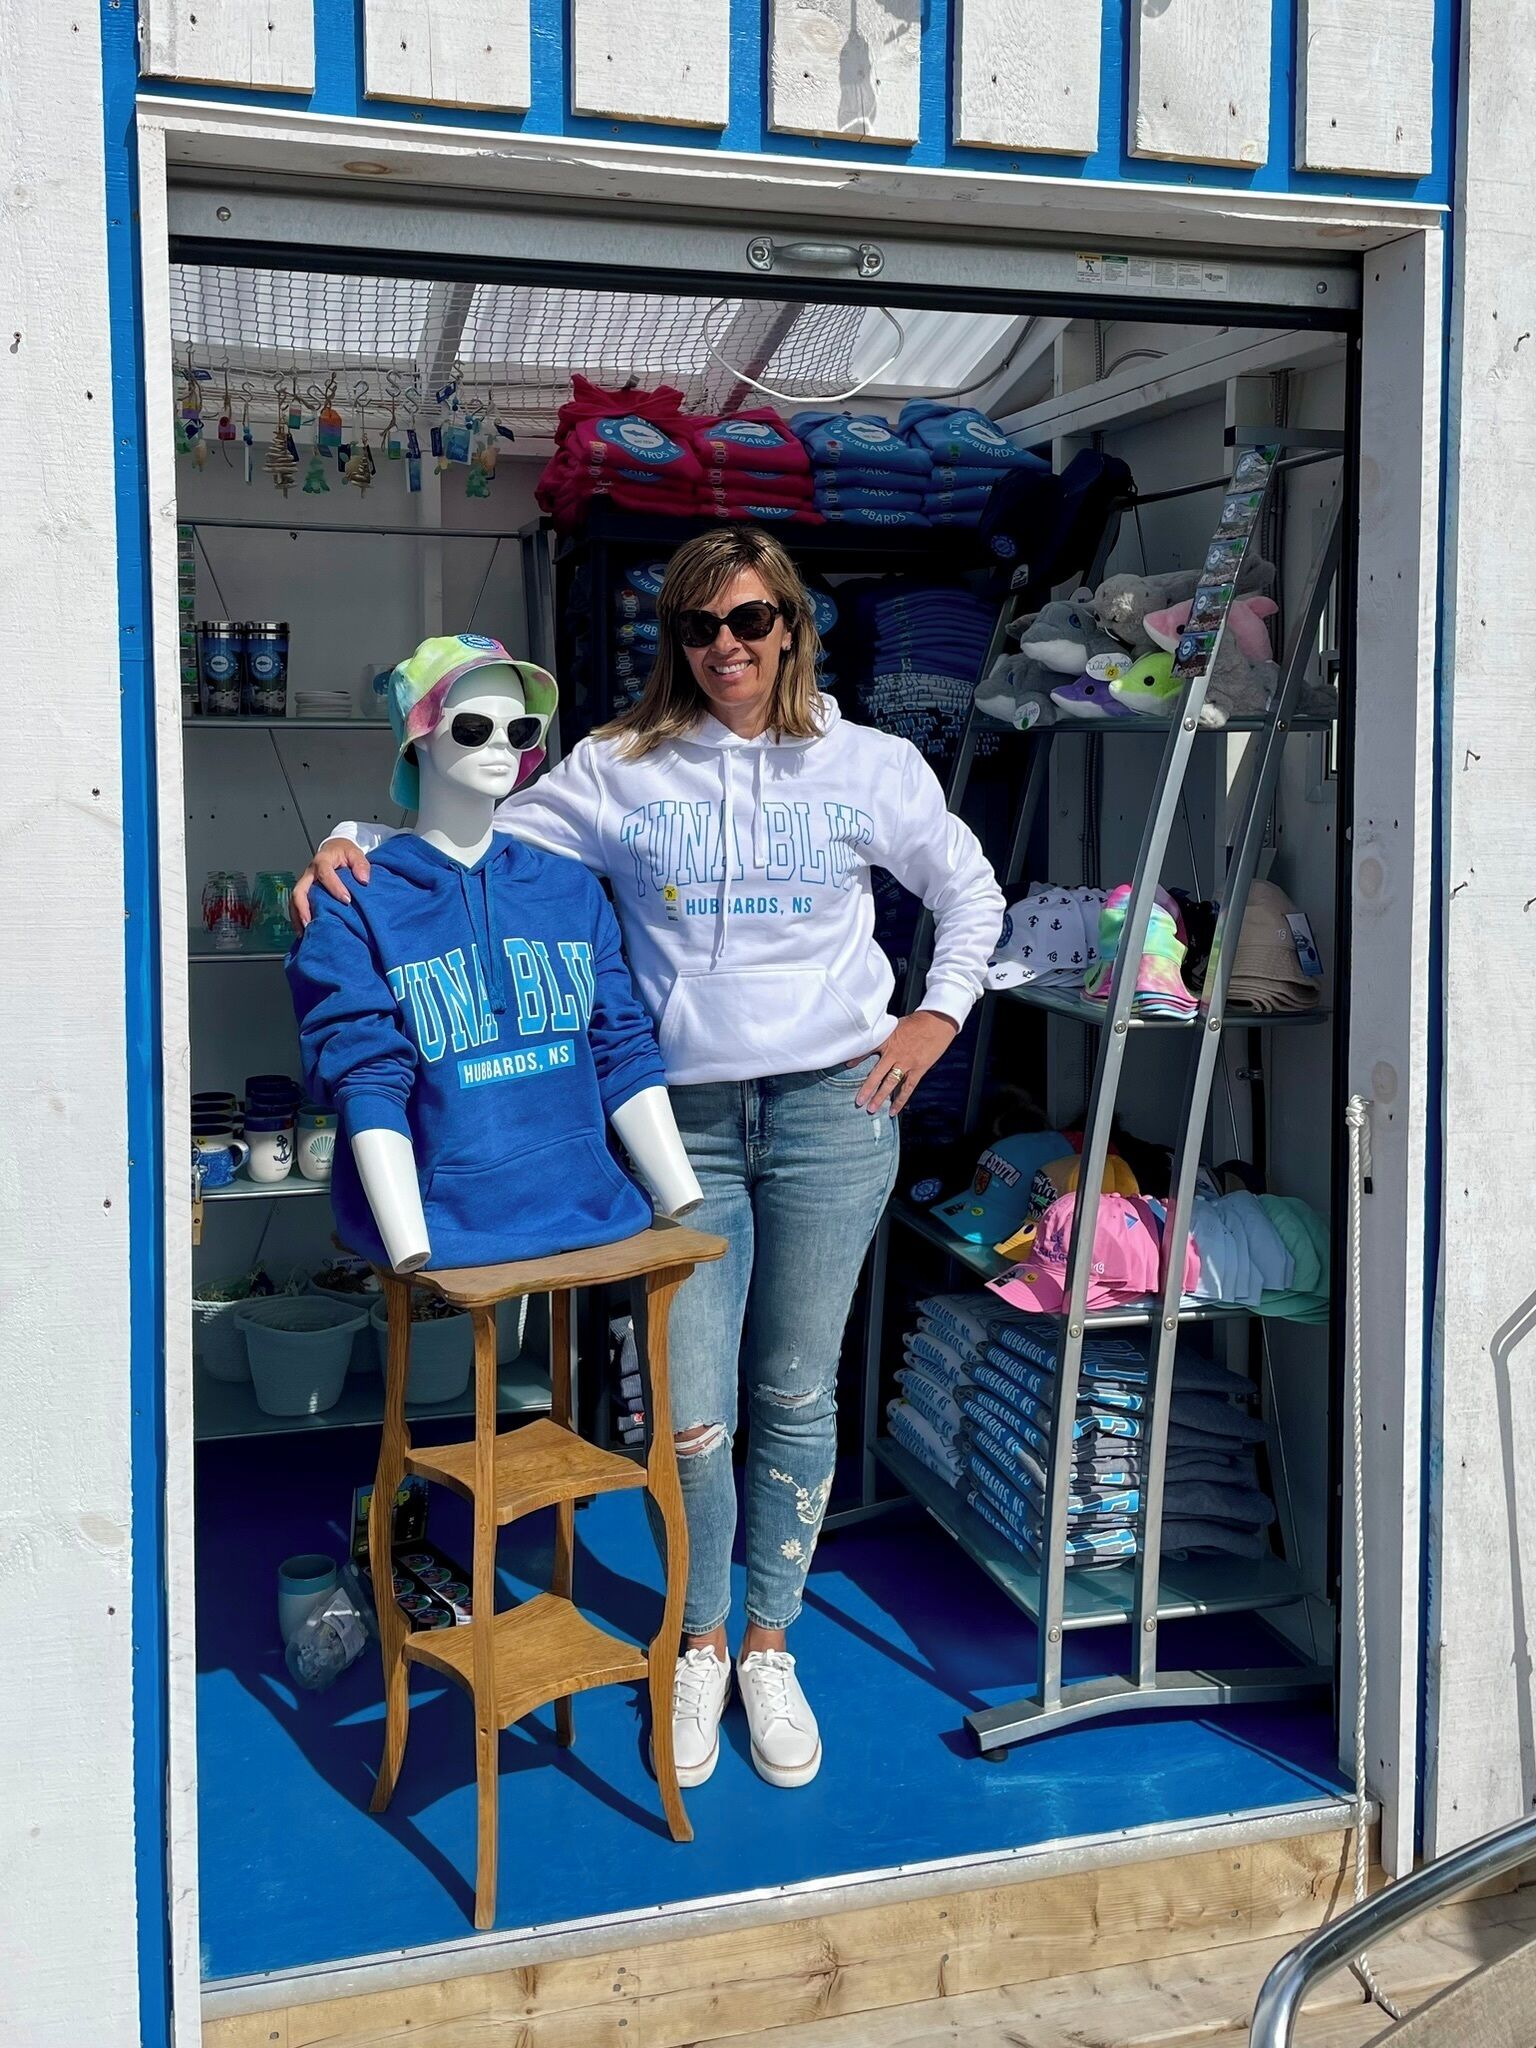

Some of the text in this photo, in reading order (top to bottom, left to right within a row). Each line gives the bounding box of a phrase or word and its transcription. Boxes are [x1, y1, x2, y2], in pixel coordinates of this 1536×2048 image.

[620, 800, 744, 898] TUNA
[685, 897, 785, 916] HUBARDS,
[792, 896, 813, 913] NS
[503, 937, 596, 1036] BLU
[463, 1044, 570, 1084] HUBBARDS, NS
[1019, 1396, 1036, 1415] NS
[1011, 1496, 1025, 1518] NS
